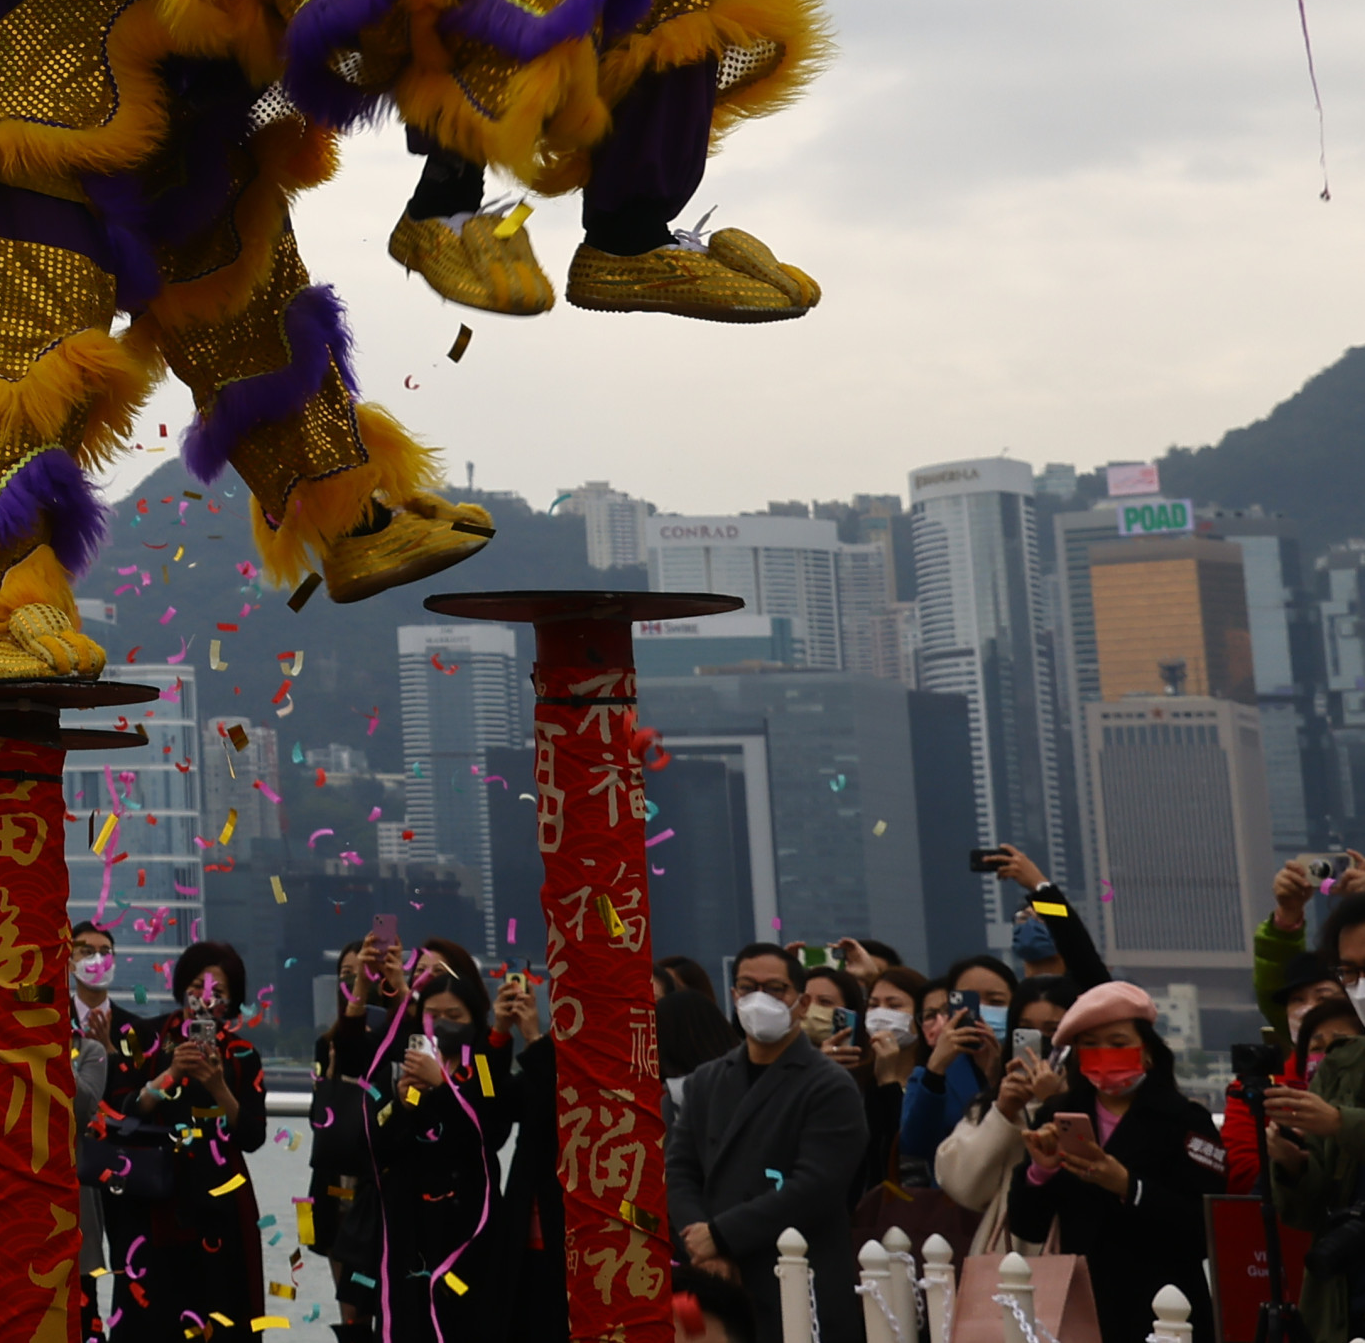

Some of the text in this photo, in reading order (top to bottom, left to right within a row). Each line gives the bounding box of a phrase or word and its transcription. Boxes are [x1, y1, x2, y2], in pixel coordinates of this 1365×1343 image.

[1124, 503, 1187, 533] POAD
[660, 525, 739, 539] CONRAD
[1254, 1250, 1267, 1262] VI
